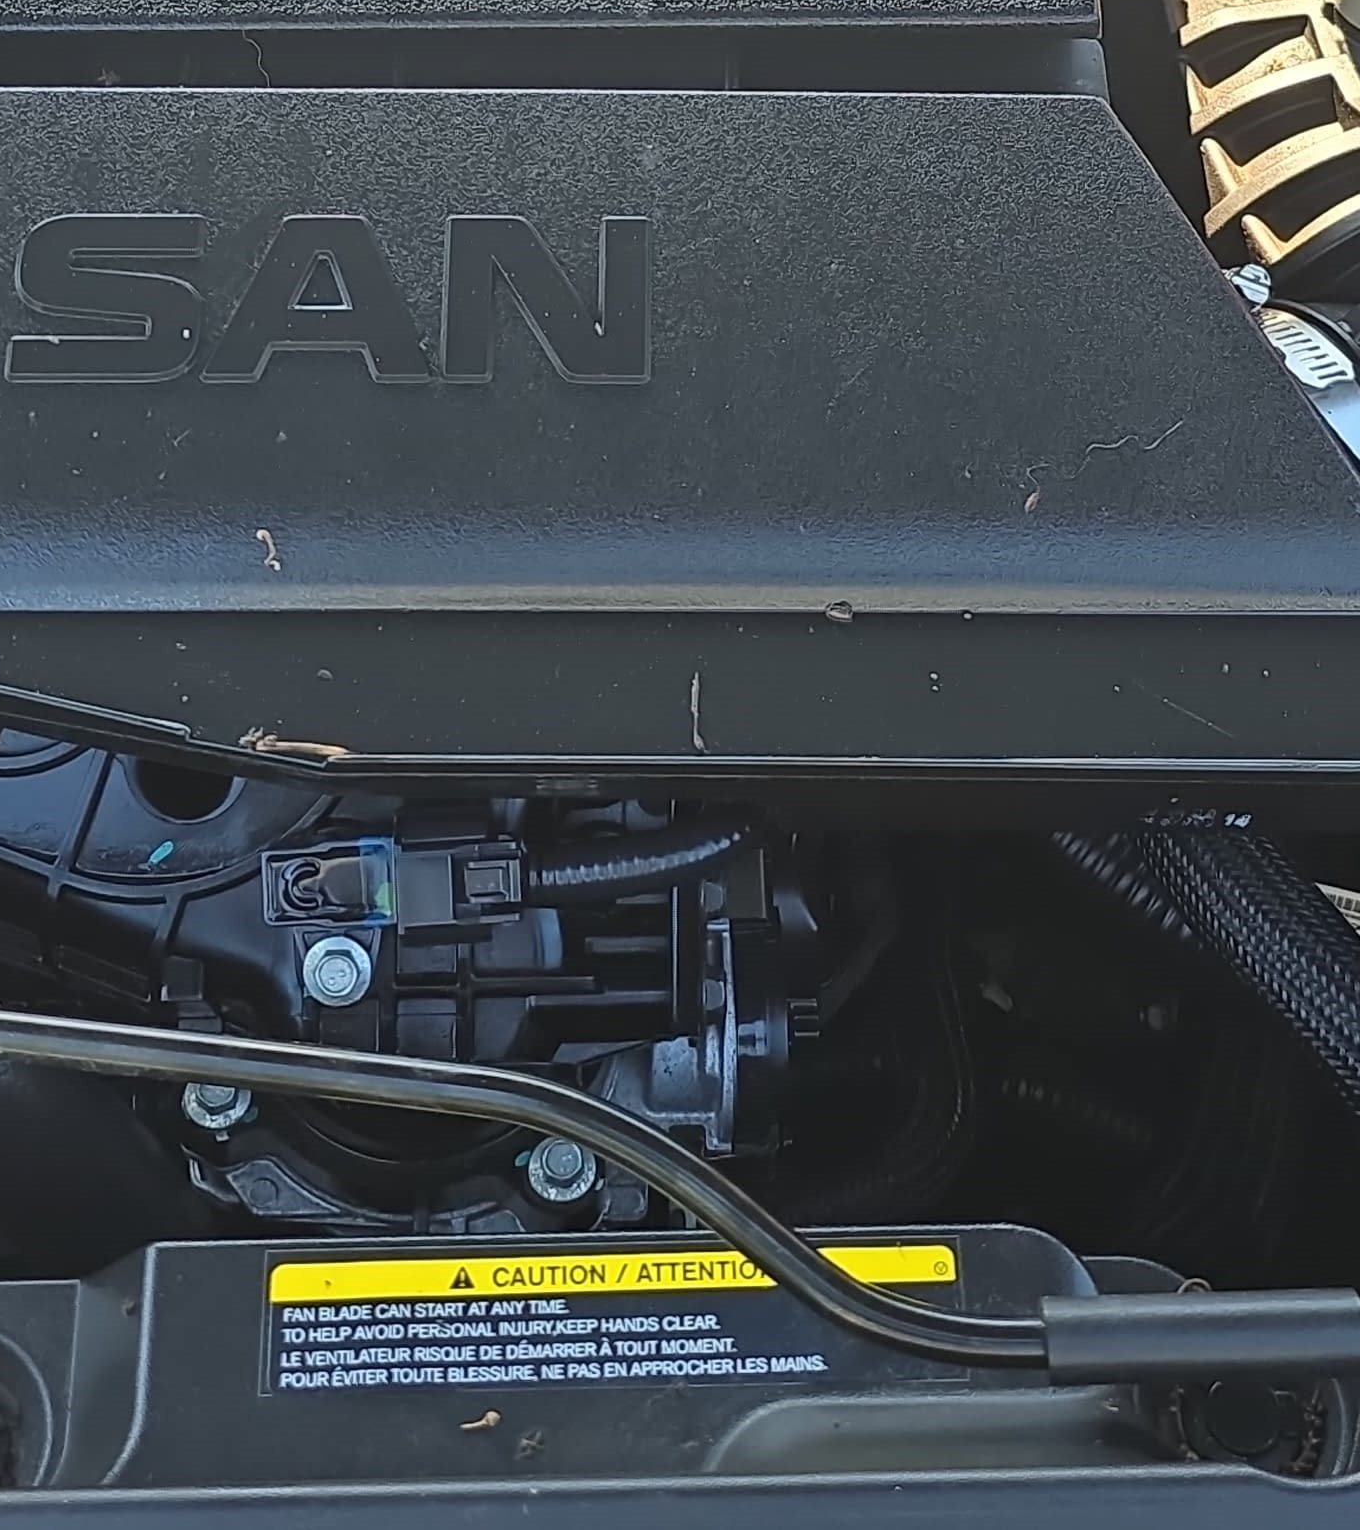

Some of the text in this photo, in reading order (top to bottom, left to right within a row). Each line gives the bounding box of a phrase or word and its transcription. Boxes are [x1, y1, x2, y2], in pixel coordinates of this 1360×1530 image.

[492, 1260, 767, 1288] CAUTION / ATTENTIO
[283, 1298, 570, 1322] FAN BLADE CAN START AT ANY TIME.
[281, 1327, 306, 1343] TO
[308, 1325, 352, 1342] HELP
[353, 1323, 405, 1340] AVOID
[407, 1321, 496, 1338] PERSONAL
[600, 1316, 659, 1333] HANDS
[661, 1315, 720, 1331] CLEAR.
[280, 1337, 738, 1367] LE VENTILATEUR RISQUE DE DÉMARRER À TOUT MOMENT.
[279, 1354, 829, 1388] POUR ÉVITER TOUTE BLESSURE, NE PAS EN APPROCHER LES MAINS.
